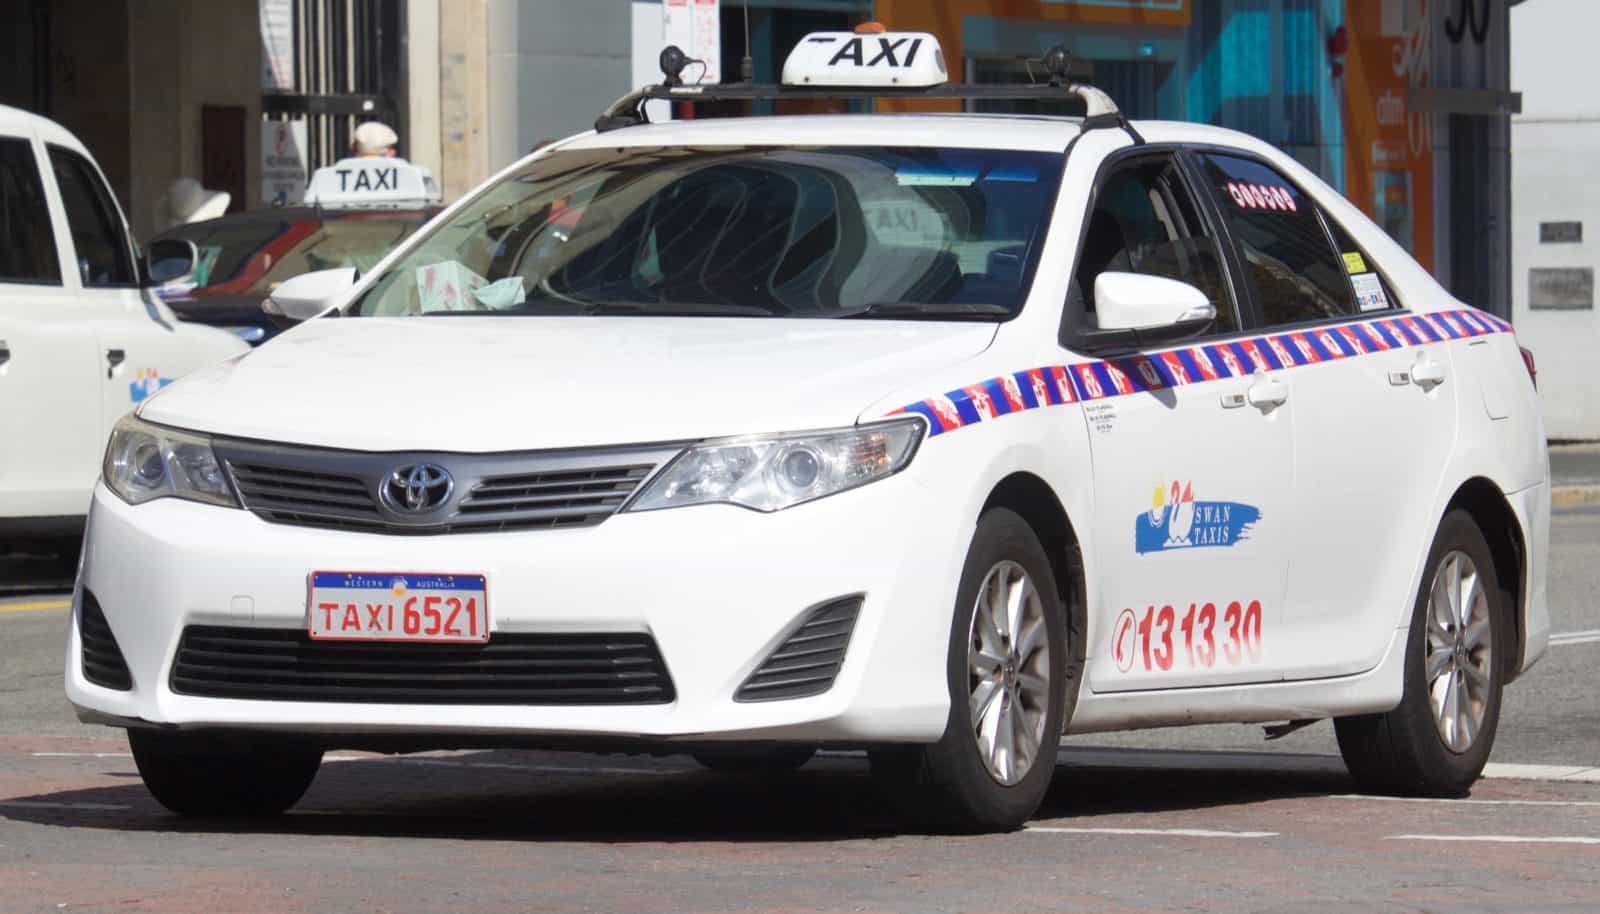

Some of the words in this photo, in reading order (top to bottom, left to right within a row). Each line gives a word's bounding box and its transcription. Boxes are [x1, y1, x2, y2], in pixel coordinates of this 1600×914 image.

[335, 167, 398, 192] TAXI
[1193, 505, 1231, 524] SWAN
[1194, 525, 1230, 545] TAXIS
[344, 579, 384, 589] WESTERN
[416, 580, 456, 588] AUSTRALIA
[318, 602, 394, 632] TAXI
[403, 596, 478, 637] 6521
[1138, 604, 1175, 672] 13
[1181, 602, 1217, 669] 13
[1223, 600, 1262, 666] 30
